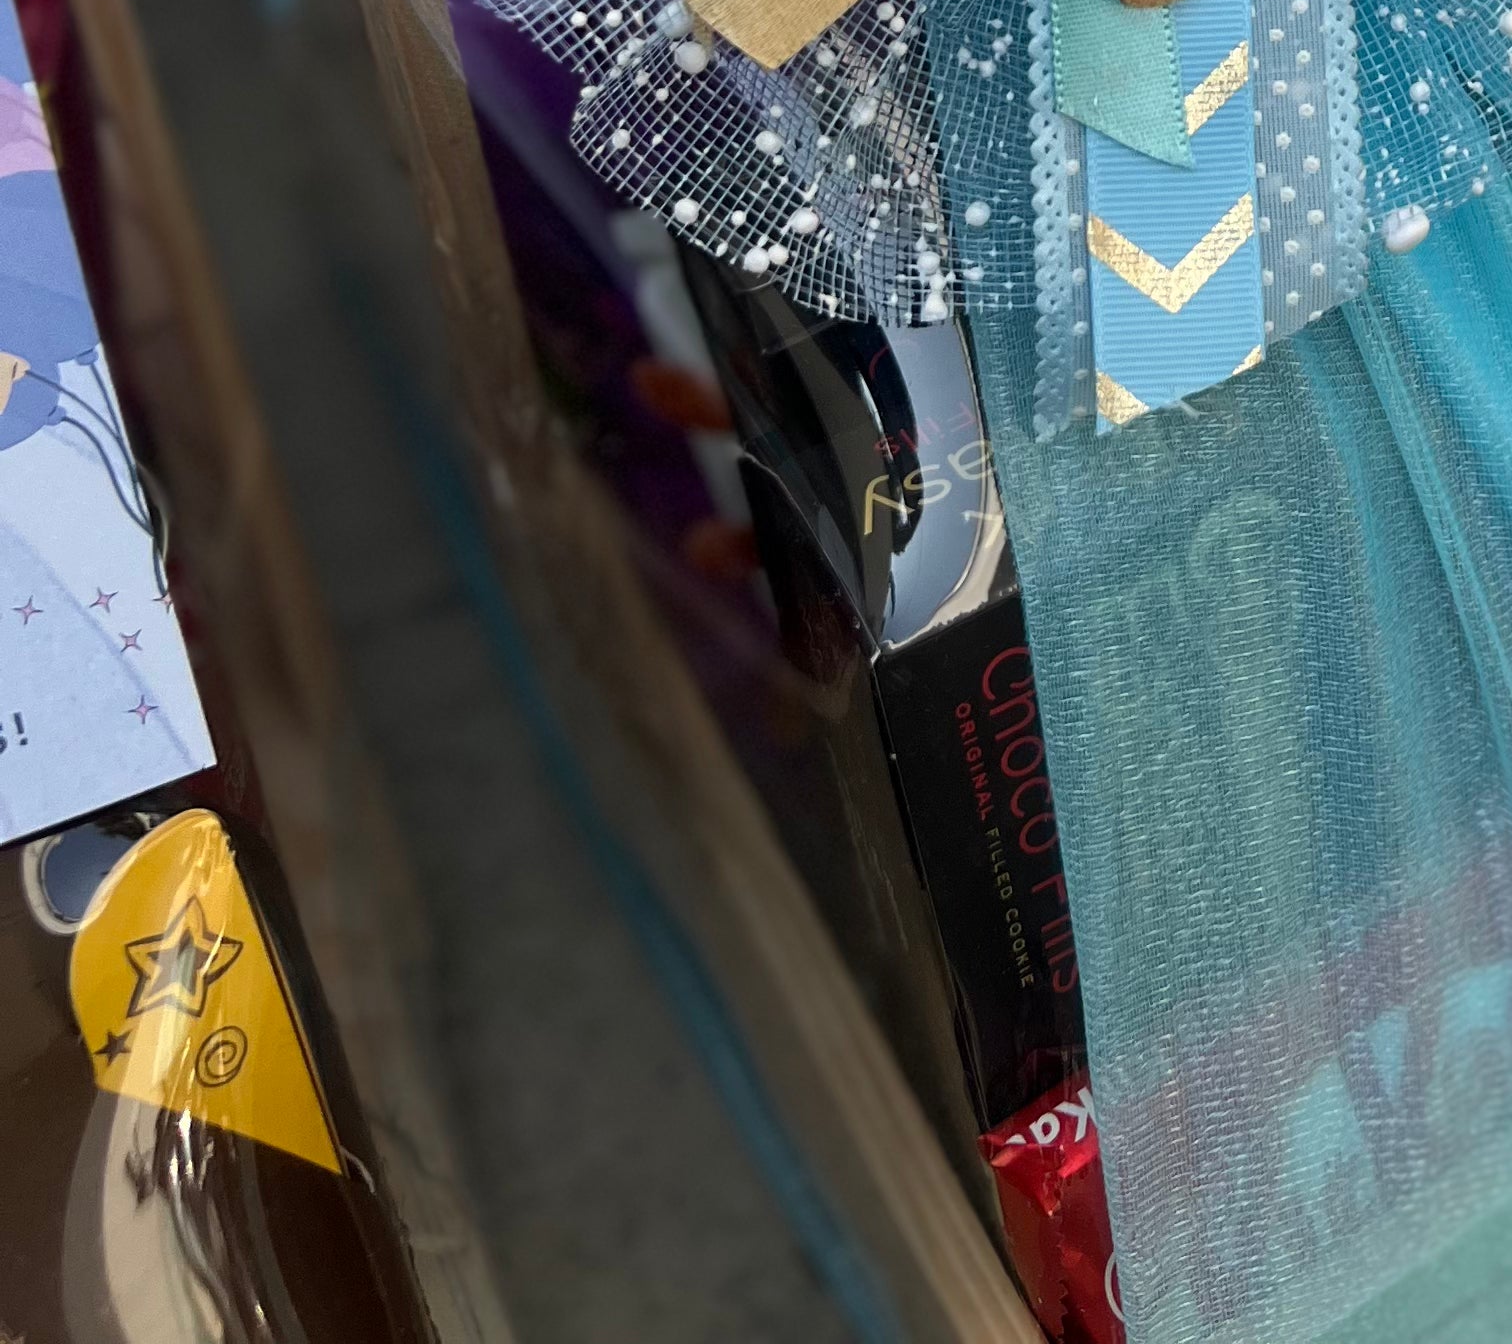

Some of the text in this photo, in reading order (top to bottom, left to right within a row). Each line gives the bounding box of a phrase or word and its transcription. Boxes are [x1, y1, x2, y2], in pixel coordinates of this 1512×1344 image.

[956, 702, 1034, 988] ORIGINAL FILLED COOKIE
[981, 646, 1058, 855] Choco
